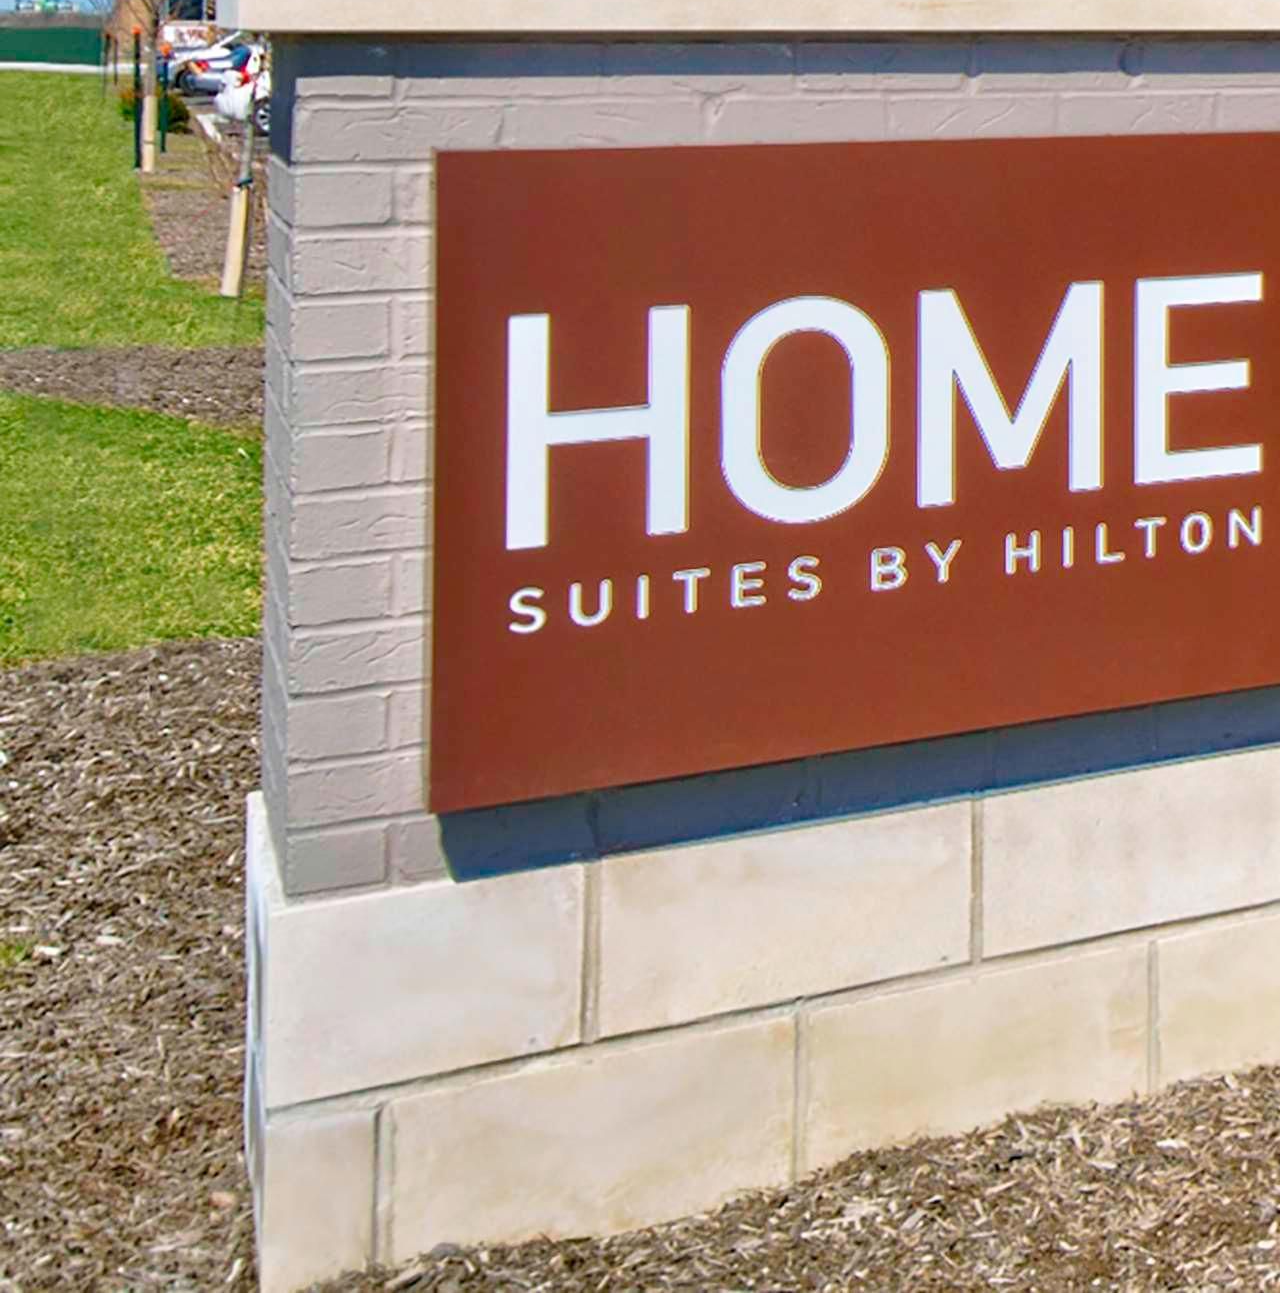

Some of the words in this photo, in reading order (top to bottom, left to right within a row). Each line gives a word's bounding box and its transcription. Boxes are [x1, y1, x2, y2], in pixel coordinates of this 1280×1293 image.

[507, 554, 823, 636] SUITES
[869, 538, 963, 593] BY
[1003, 505, 1263, 577] HILTON
